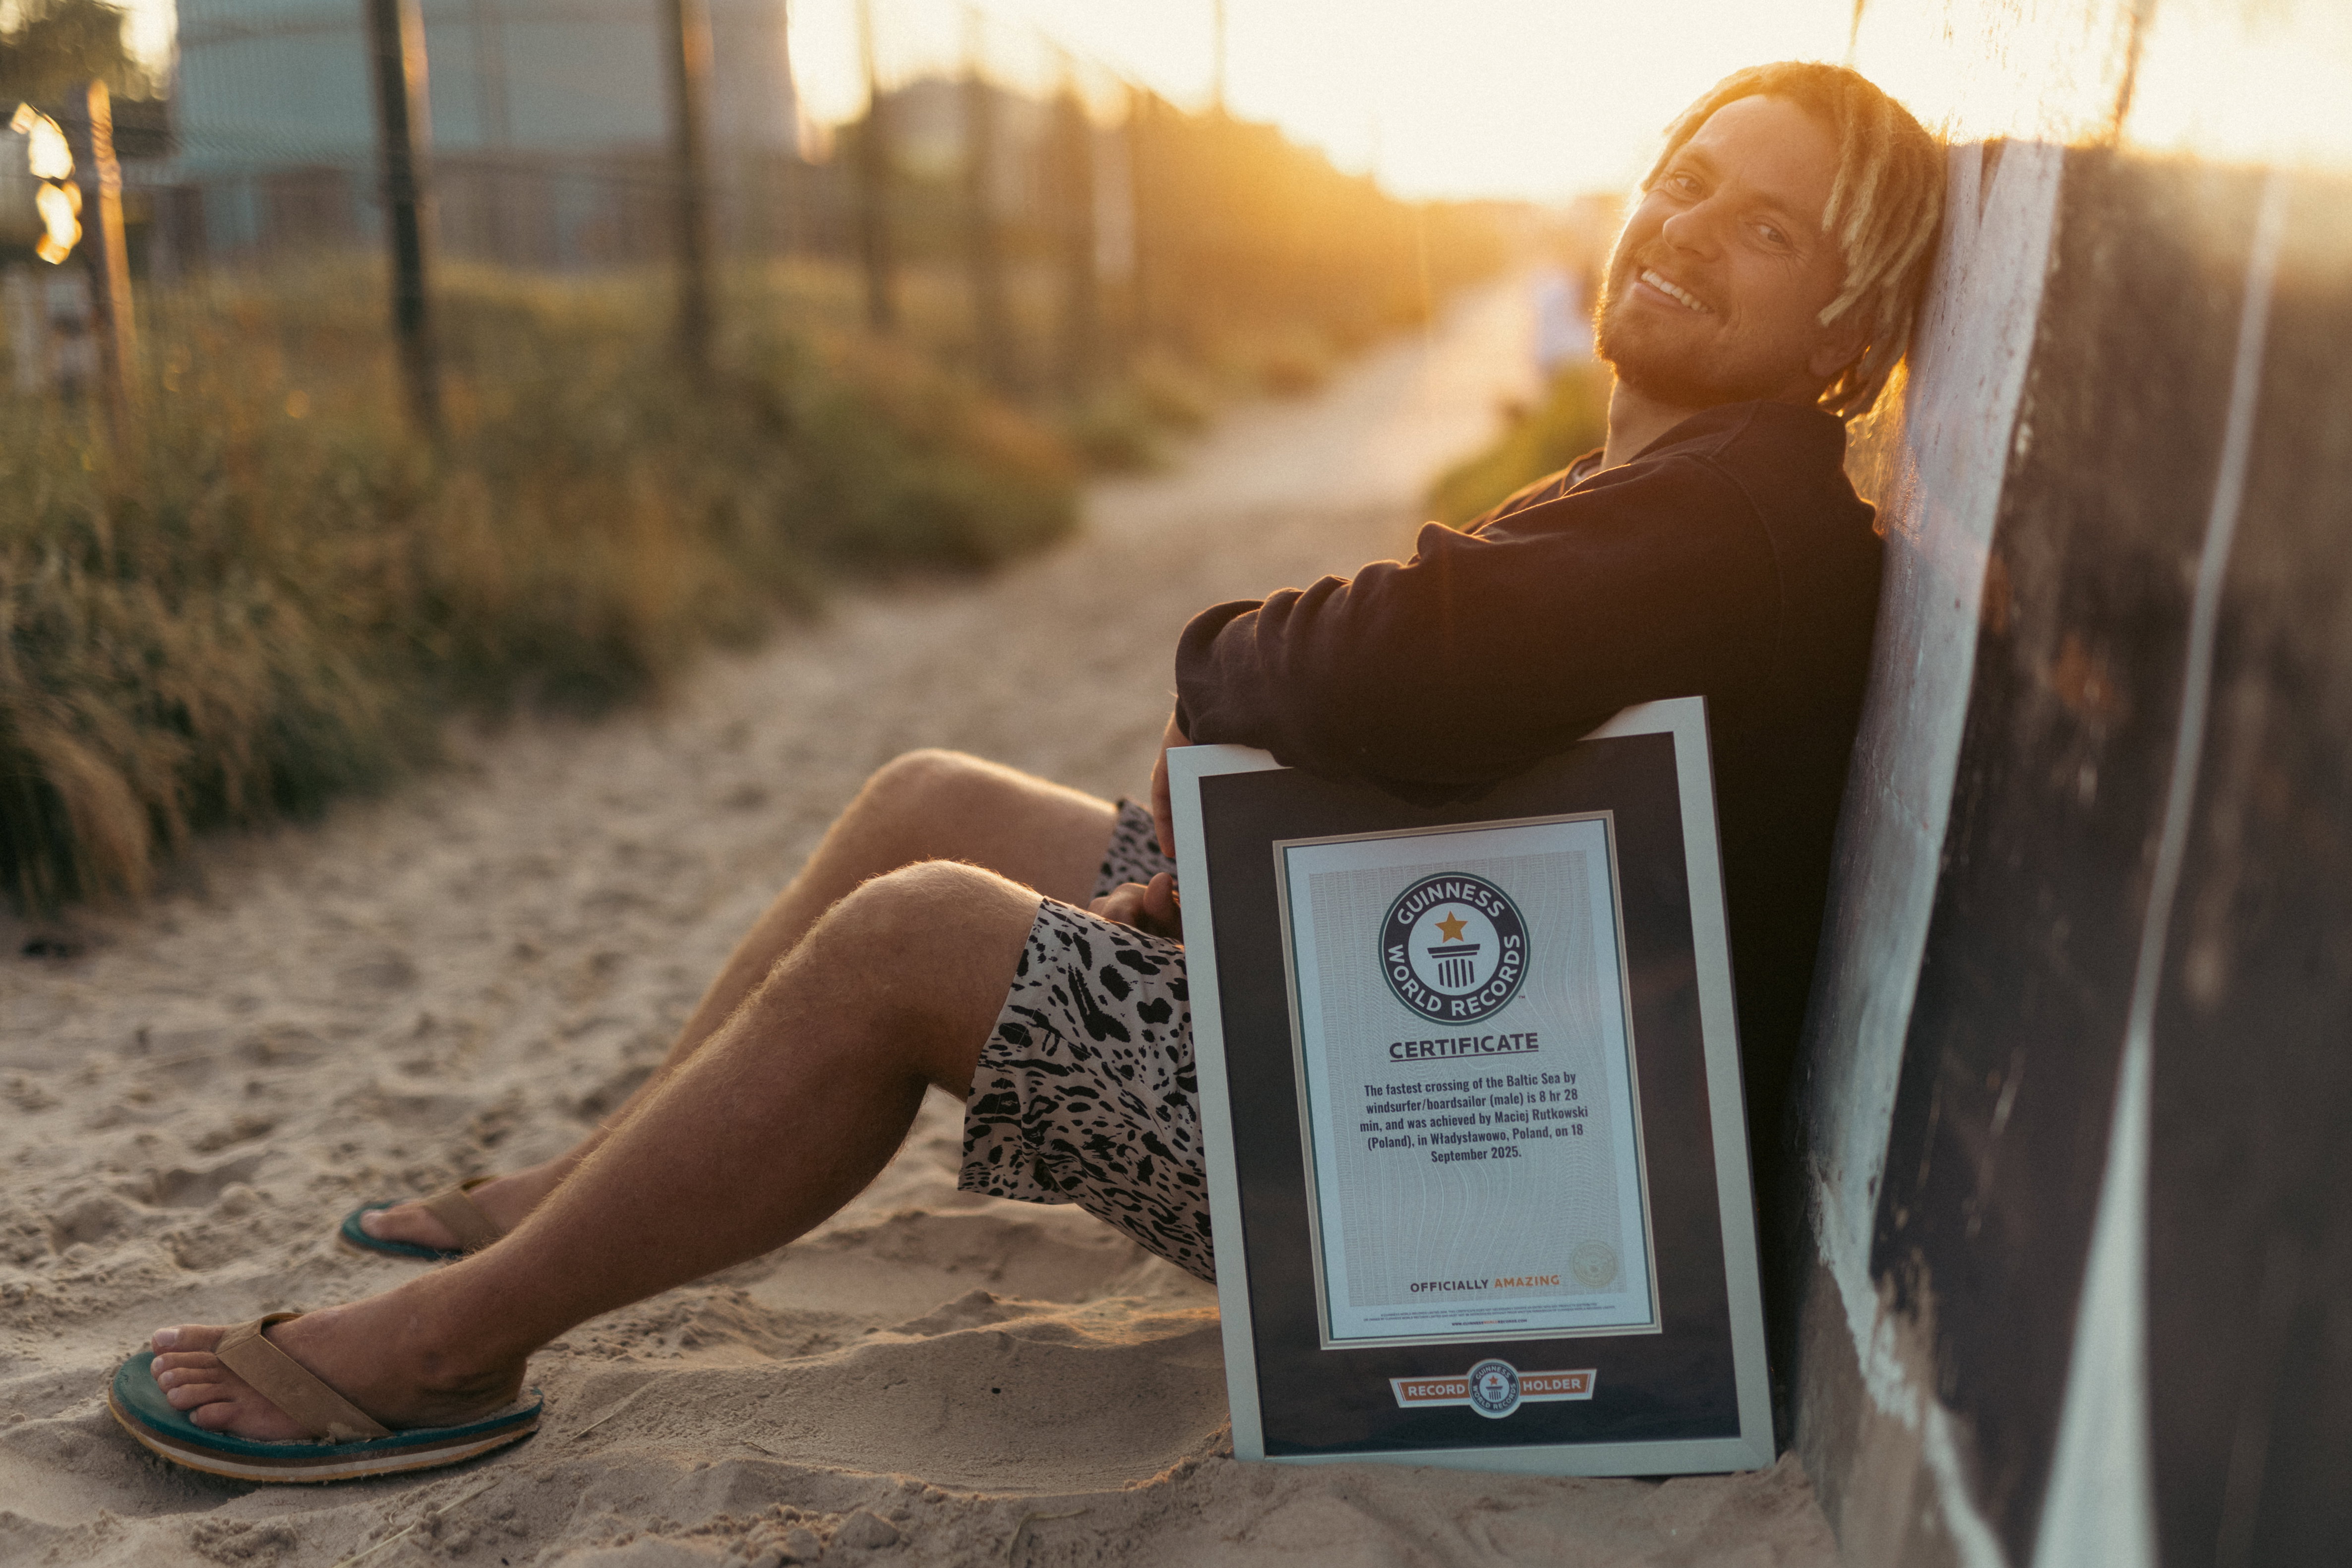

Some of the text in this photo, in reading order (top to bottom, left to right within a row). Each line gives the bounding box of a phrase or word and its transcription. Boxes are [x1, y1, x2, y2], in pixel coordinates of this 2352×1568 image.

[1397, 882, 1505, 924] GUINNESS
[1388, 934, 1520, 1016] WORLD RECORDS
[1389, 1032, 1539, 1059] CERTIFICATE
[1364, 1072, 1575, 1096] The fastest crossing of the Baltic Sea by
[1366, 1088, 1577, 1114] windsurfer/boardsailor (male) is 8 hr 28
[1360, 1106, 1588, 1132] min, and was achieved by Maciej Rutkowski
[1368, 1124, 1583, 1151] (Poland), in Władysławowo, Poland, on 18
[1431, 1146, 1521, 1164] September 2025.
[1410, 1274, 1560, 1293] OFFICIALLY AMAZING
[1475, 1365, 1511, 1381] GUINNESS
[1408, 1379, 1581, 1396] RECORD HOLDER
[1473, 1384, 1516, 1410] WORLD RECORDS
